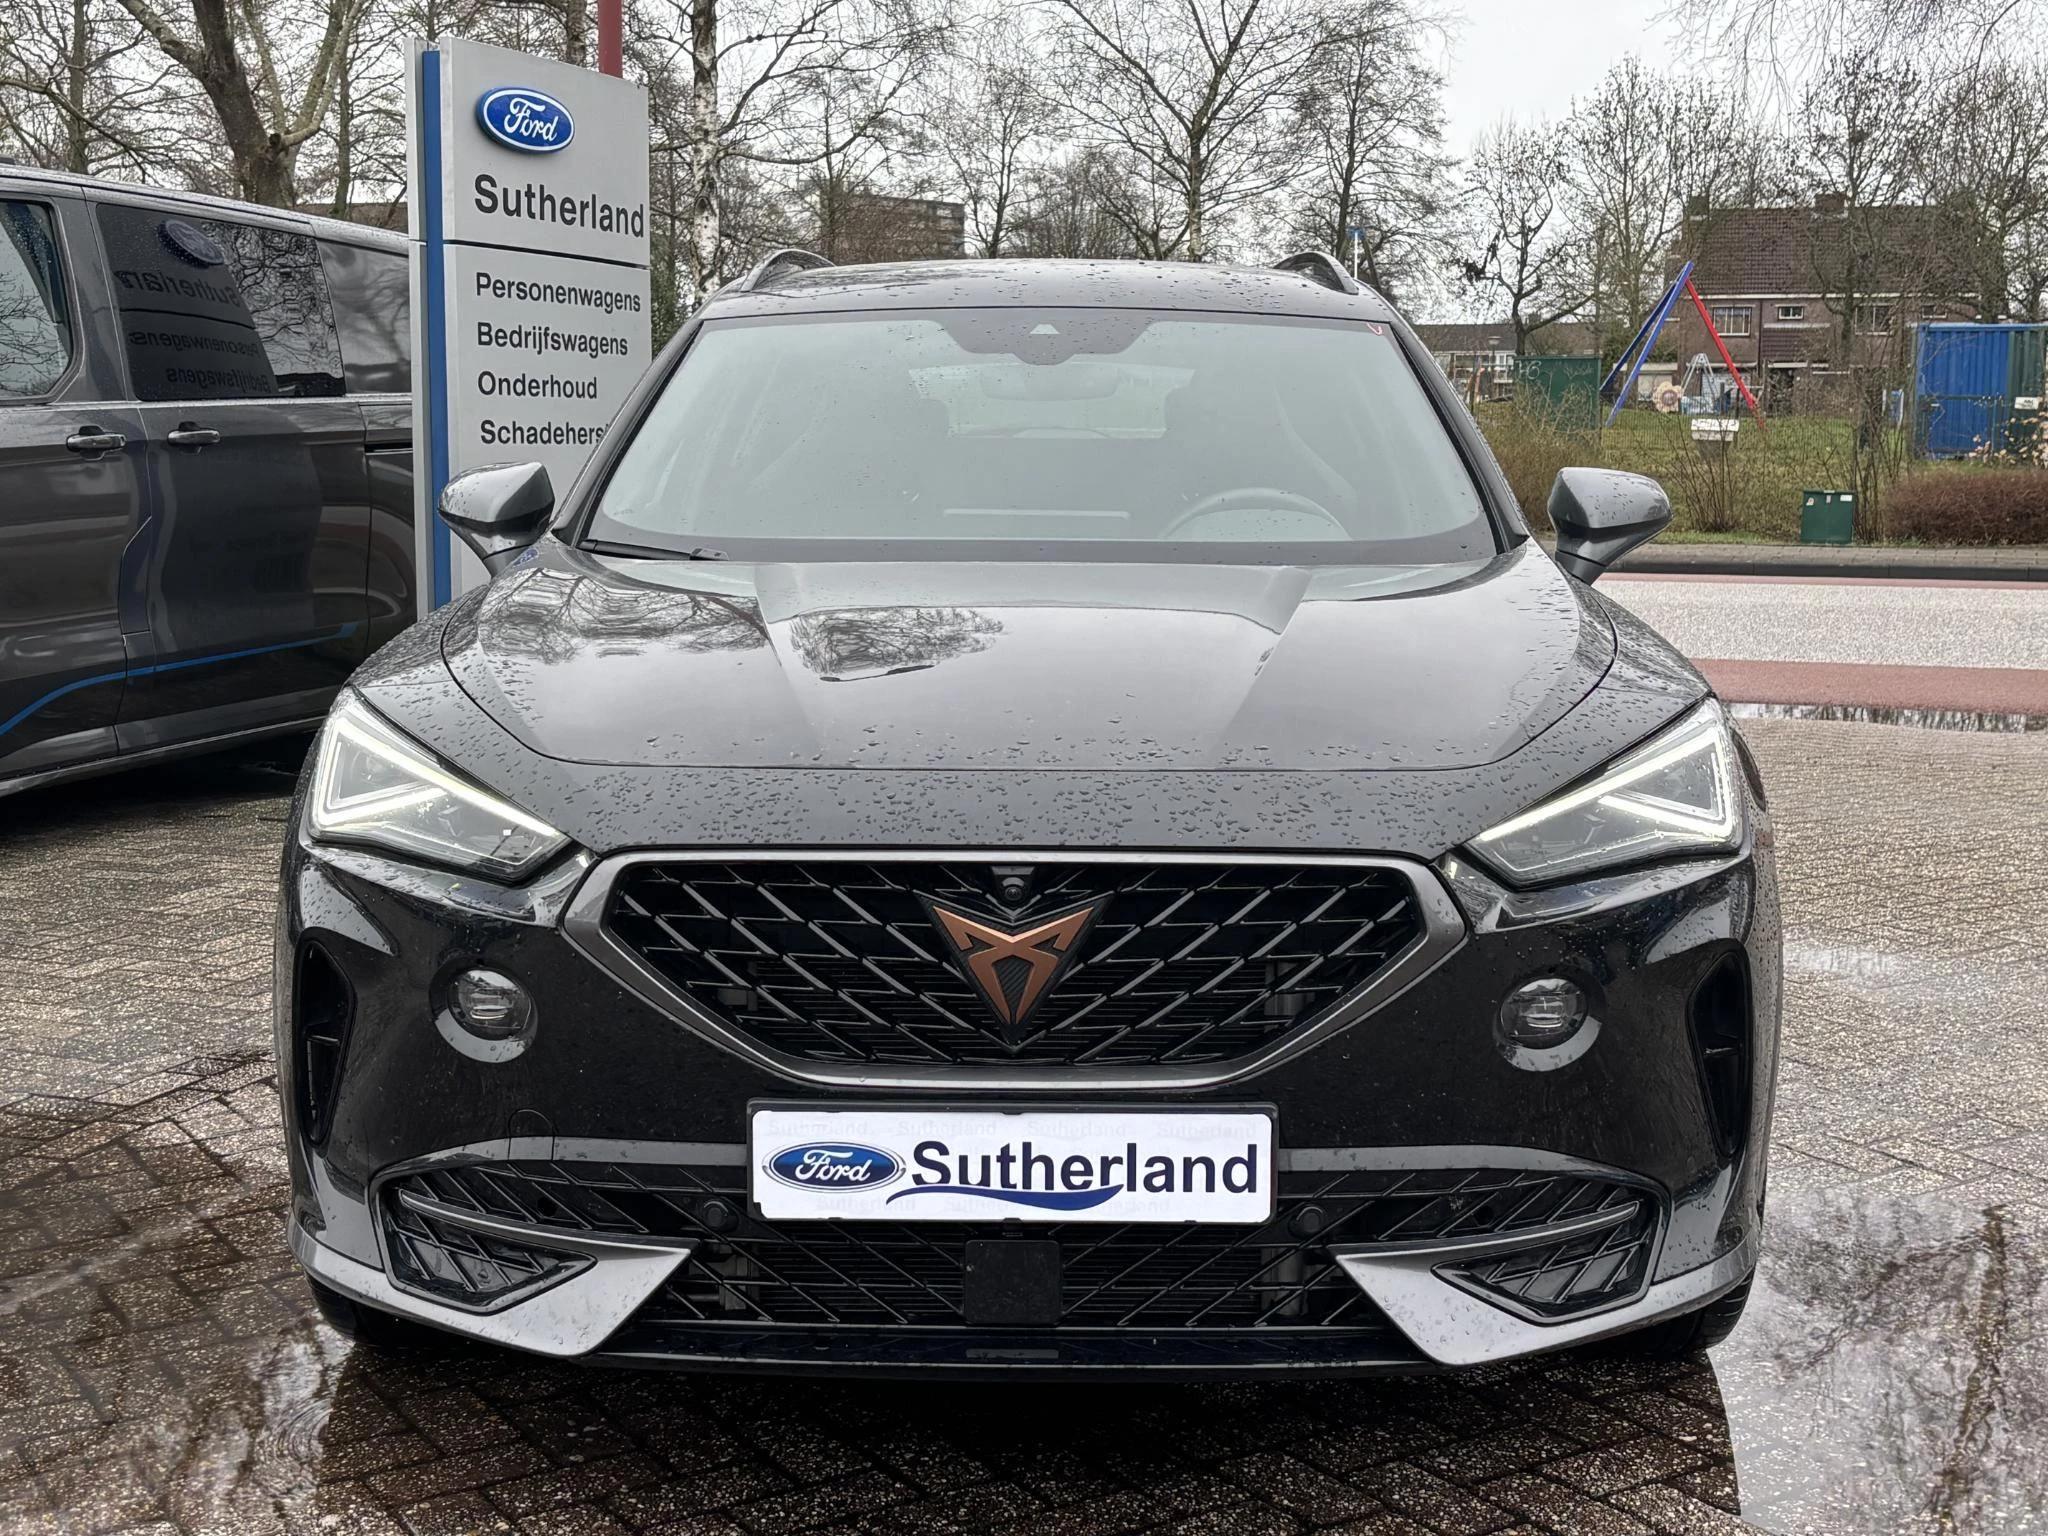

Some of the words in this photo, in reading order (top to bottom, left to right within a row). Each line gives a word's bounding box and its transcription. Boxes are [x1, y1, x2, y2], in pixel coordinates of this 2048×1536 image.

[503, 96, 558, 143] Ford
[474, 173, 645, 239] Sutherland
[476, 271, 642, 315] Personenwagens
[476, 321, 629, 360] Bedrijfswagens
[477, 370, 598, 400] Onderhoud
[480, 419, 609, 446] Schadehers
[794, 1149, 872, 1183] Ford
[912, 1140, 1258, 1194] Sutherland
